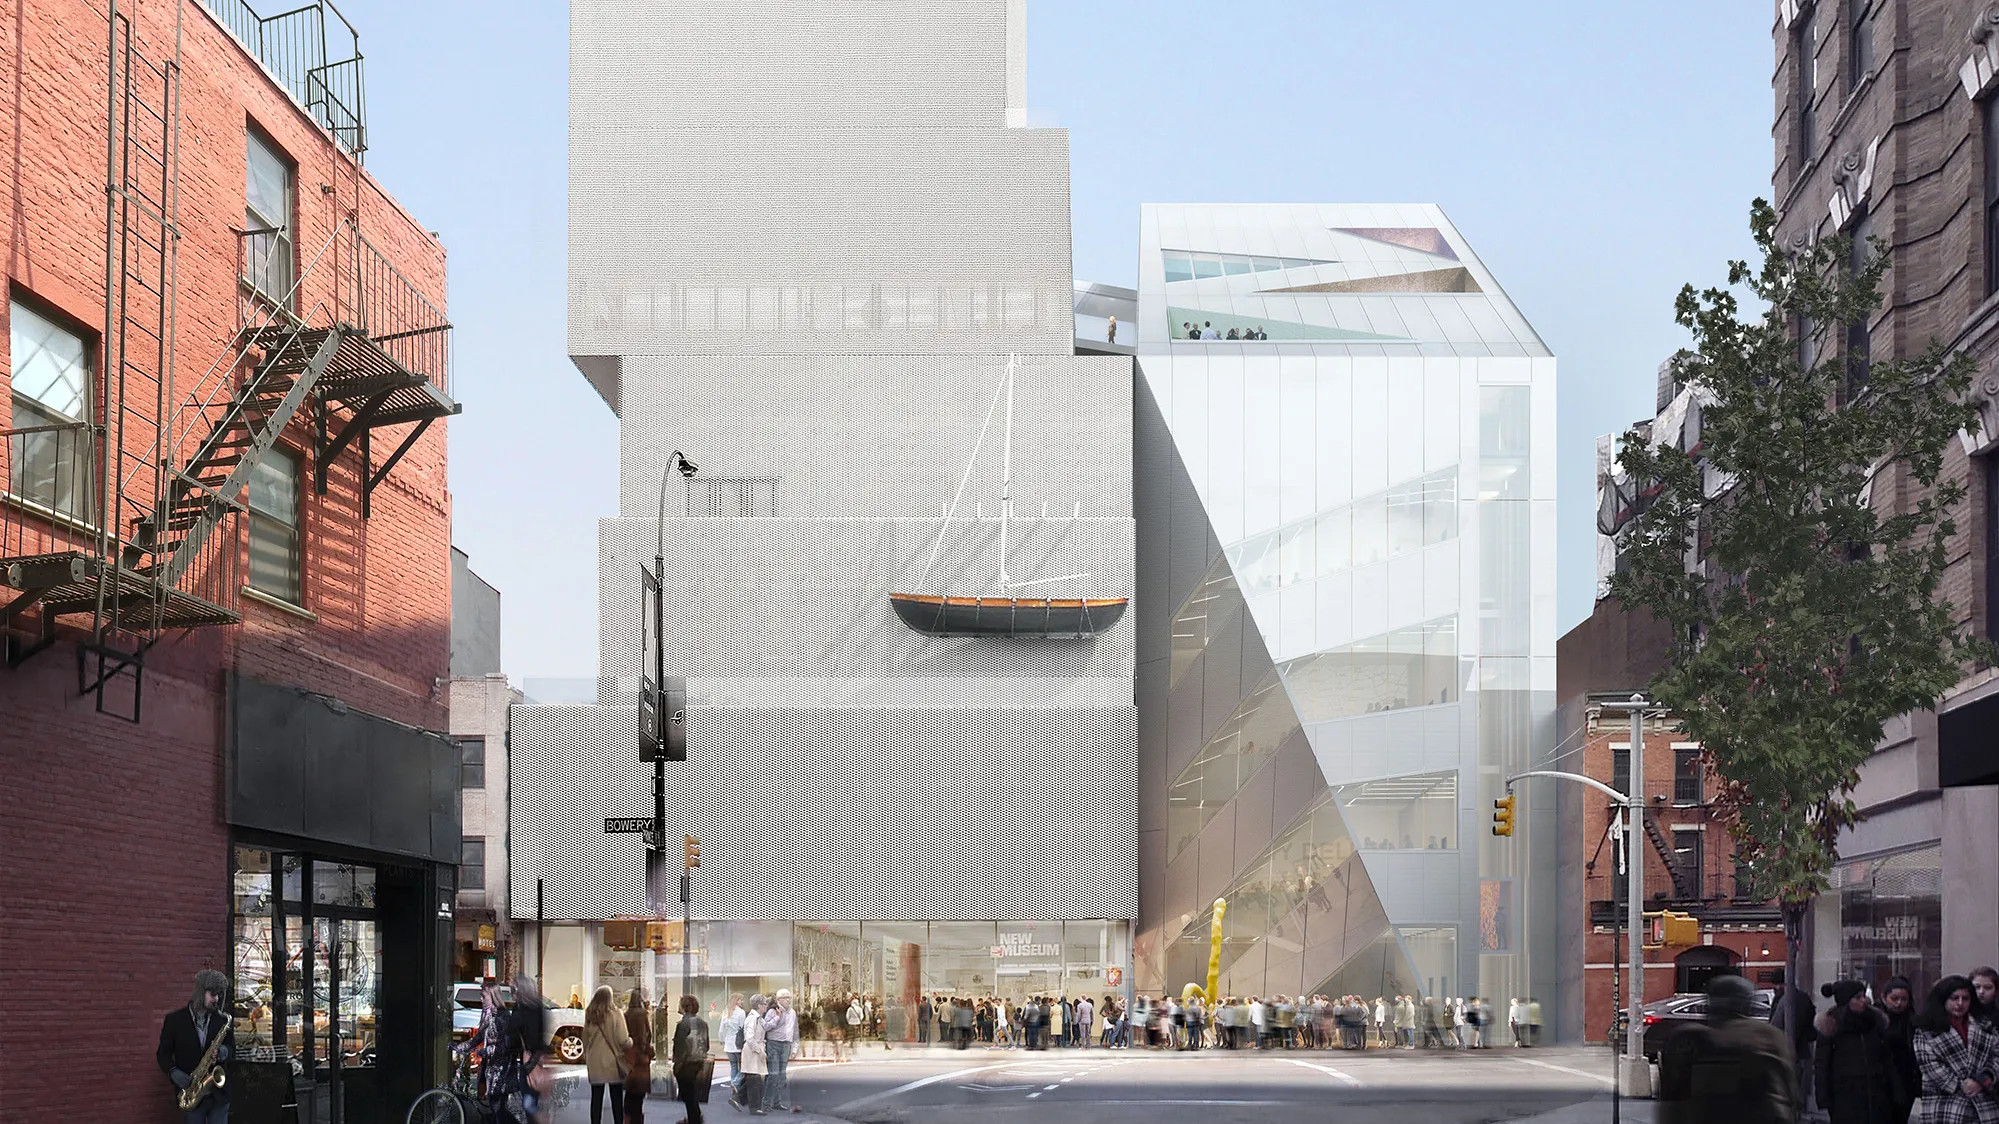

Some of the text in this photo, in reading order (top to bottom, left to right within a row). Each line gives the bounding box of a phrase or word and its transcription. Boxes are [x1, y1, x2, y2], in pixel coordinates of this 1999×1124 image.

[606, 819, 652, 832] BOWERY
[478, 937, 496, 949] HOTEL
[999, 932, 1033, 945] NEW
[1000, 944, 1060, 957] MUSEUM
